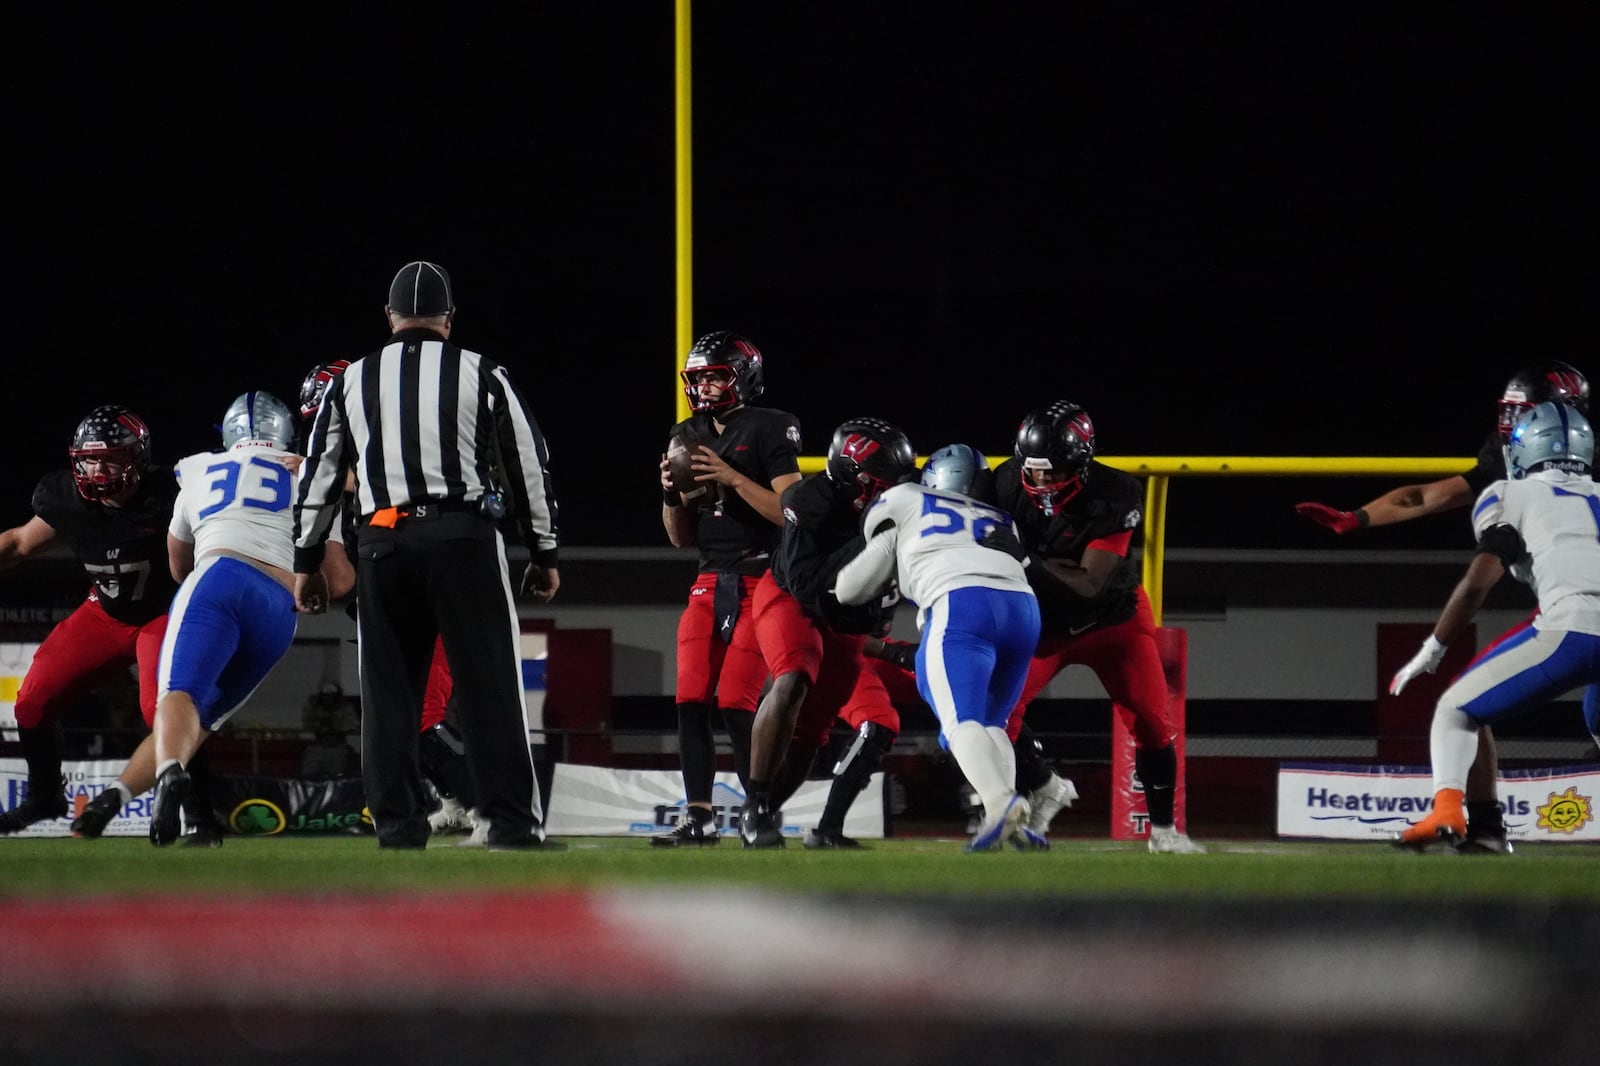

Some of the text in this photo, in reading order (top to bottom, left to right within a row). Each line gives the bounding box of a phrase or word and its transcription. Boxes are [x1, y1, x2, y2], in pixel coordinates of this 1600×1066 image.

[199, 457, 292, 518] 33
[83, 560, 151, 601] 57
[1307, 786, 1435, 814] Heatwav
